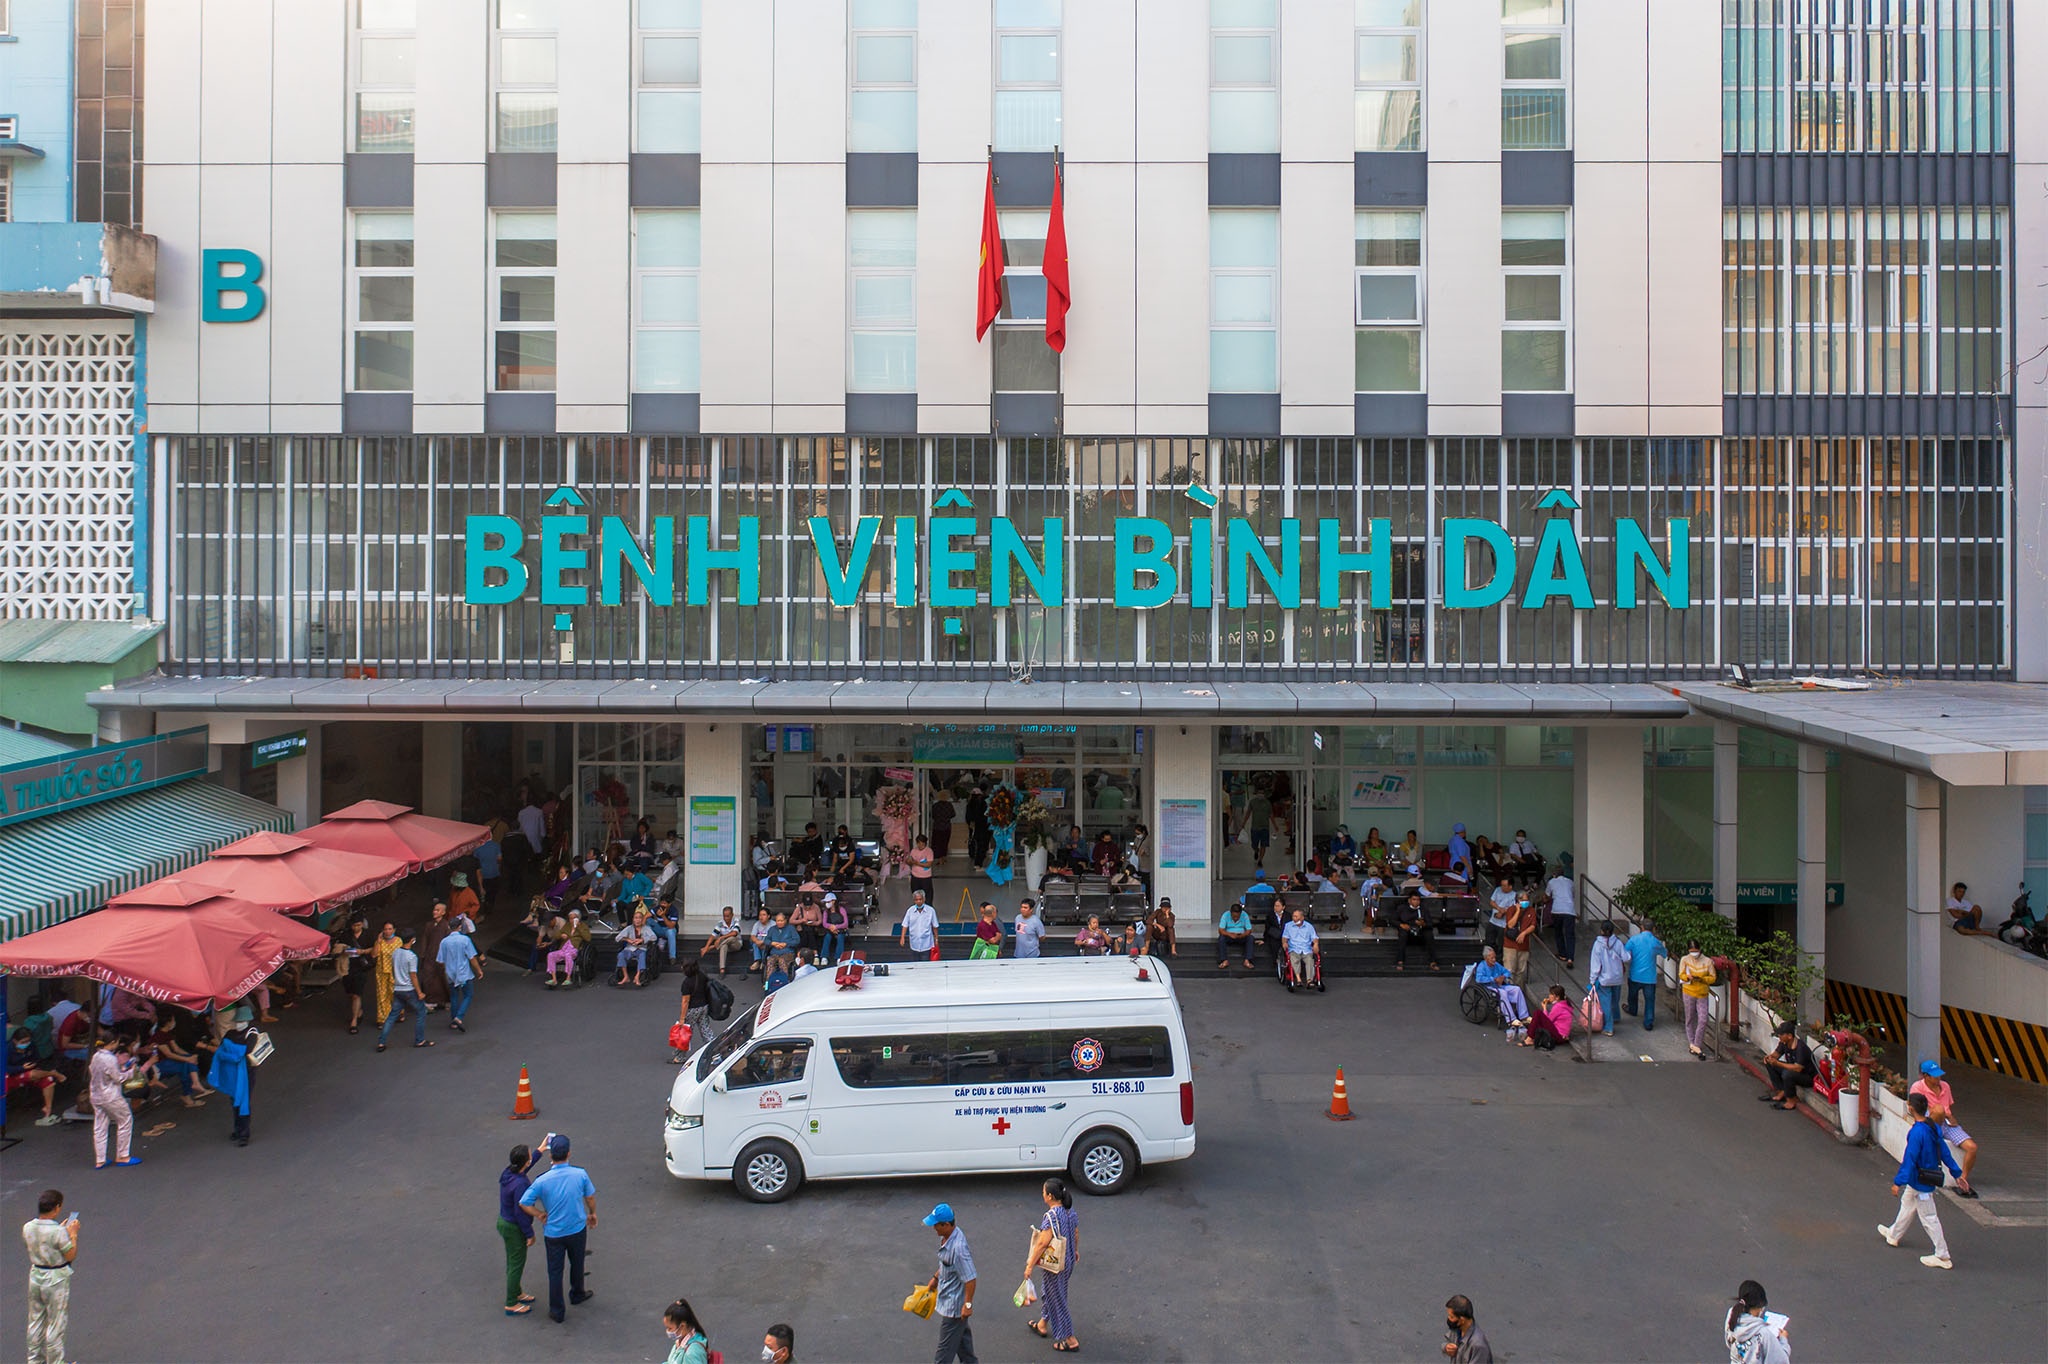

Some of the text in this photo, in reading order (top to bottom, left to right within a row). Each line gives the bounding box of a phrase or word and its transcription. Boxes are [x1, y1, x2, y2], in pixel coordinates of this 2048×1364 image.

[202, 248, 267, 323] B
[464, 481, 1691, 635] BỆNH VIỆN BÌNH DÂN
[12, 761, 93, 811] THUỐC
[96, 751, 127, 791] SỐ
[129, 758, 144, 784] 2
[1688, 885, 1706, 897] GIỮ
[1753, 885, 1776, 897] VIÊN
[11, 963, 86, 976] AGRIBANK
[88, 963, 113, 982] CHI
[114, 974, 172, 1002] NHÁNH
[954, 1085, 1046, 1097] CẤP CỨU & CỨU NẠN KV4
[1091, 1080, 1145, 1095] 51L-868.10
[954, 1108, 963, 1116] XE
[972, 1106, 984, 1116] TRỢ
[984, 1106, 1001, 1116] PHỤC
[1001, 1106, 1009, 1115] VỤ
[1009, 1104, 1024, 1115] HIỆN
[1023, 1104, 1047, 1114] TRƯỜNG
